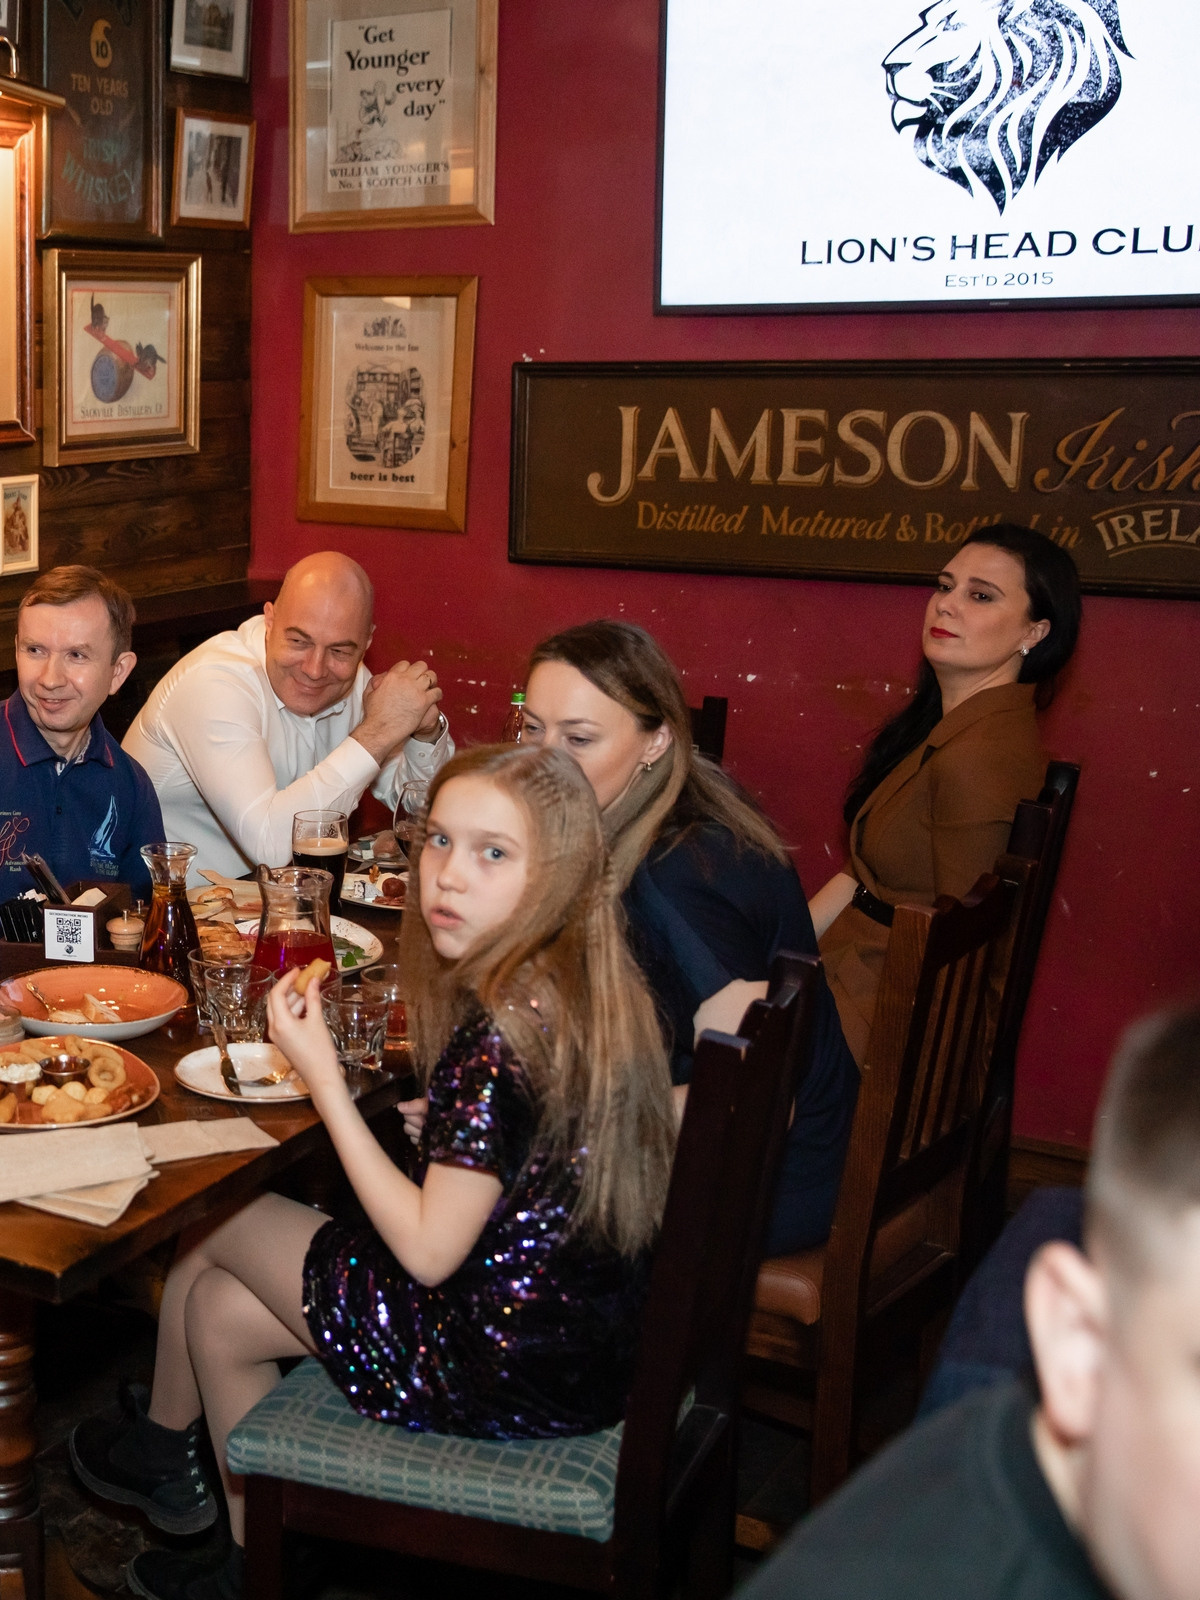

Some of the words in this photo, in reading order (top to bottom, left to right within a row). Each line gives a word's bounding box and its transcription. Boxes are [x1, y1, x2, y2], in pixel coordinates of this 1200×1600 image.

[95, 40, 108, 58] 10
[345, 49, 430, 77] Younger
[71, 73, 91, 93] TEN
[97, 77, 129, 96] YEARS
[395, 78, 445, 97] every
[91, 97, 114, 116] OLD
[329, 164, 380, 179] WILLIAM
[384, 160, 450, 176] YOUNGER'S
[366, 177, 413, 189] SCOTCH
[416, 175, 438, 187] ALE
[800, 235, 937, 266] LION'S
[949, 229, 1078, 261] HEAD
[1091, 223, 1200, 256] CLU
[1004, 271, 1054, 286] 2015
[587, 405, 1031, 507] JAMESON
[350, 472, 374, 482] beer
[378, 472, 388, 482] is
[392, 472, 415, 483] best
[637, 500, 749, 535] Distilled
[760, 504, 892, 541] Matured
[895, 514, 918, 543] &
